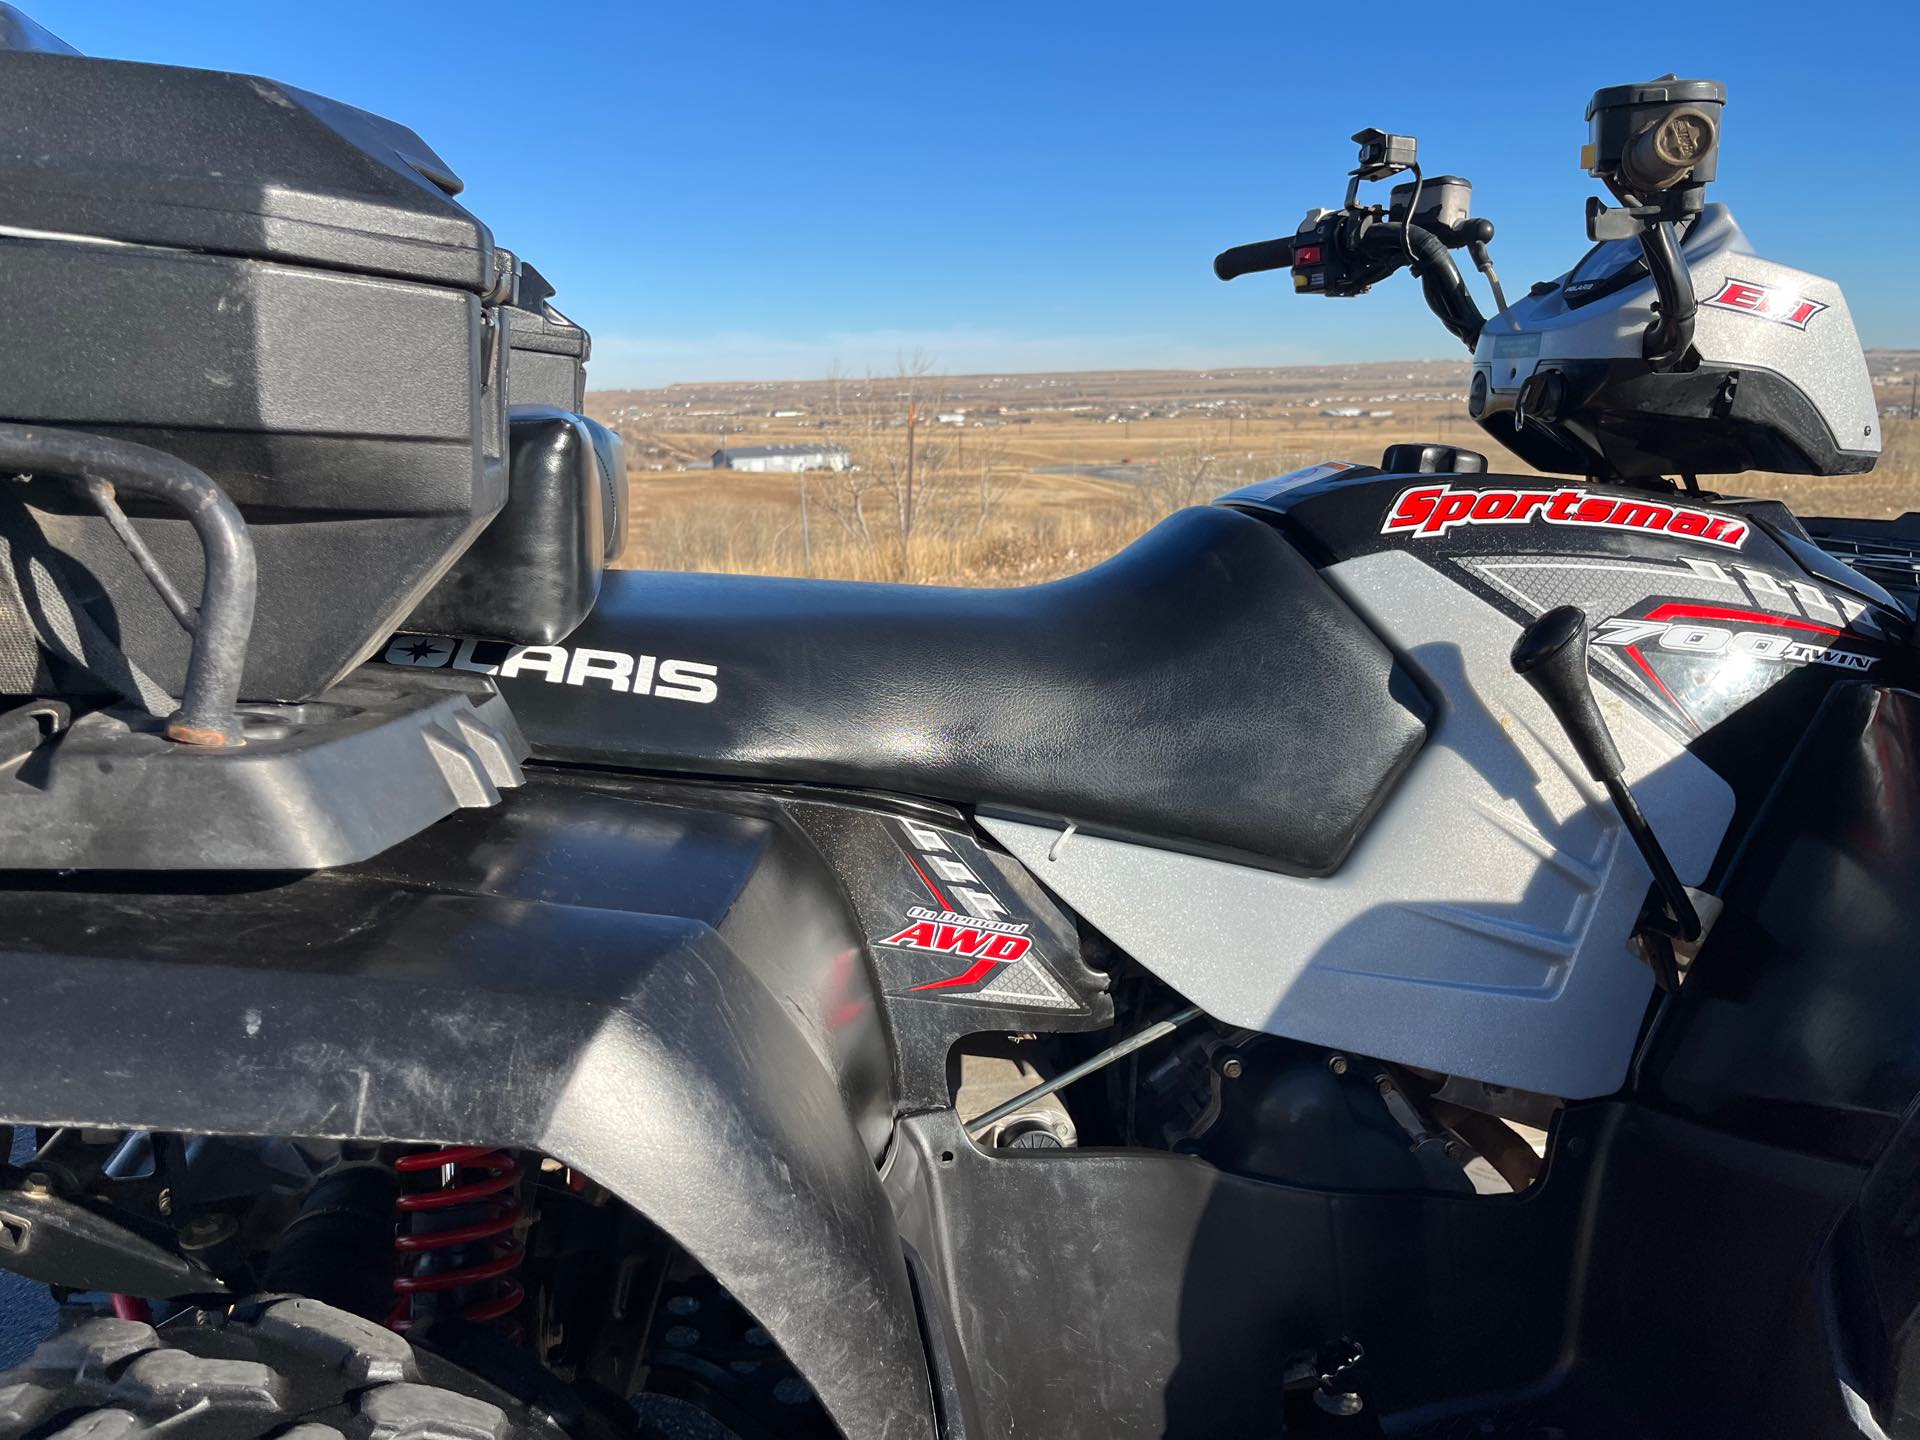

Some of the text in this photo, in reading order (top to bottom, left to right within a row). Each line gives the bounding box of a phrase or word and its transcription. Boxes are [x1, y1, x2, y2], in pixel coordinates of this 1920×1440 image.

[1712, 281, 1819, 325] EI
[1382, 484, 1749, 549] Sportsman
[1591, 617, 1876, 671] 700 TWIN
[384, 635, 718, 704] OLARIS
[879, 920, 1033, 963] AWD
[907, 906, 1029, 935] On Demand
